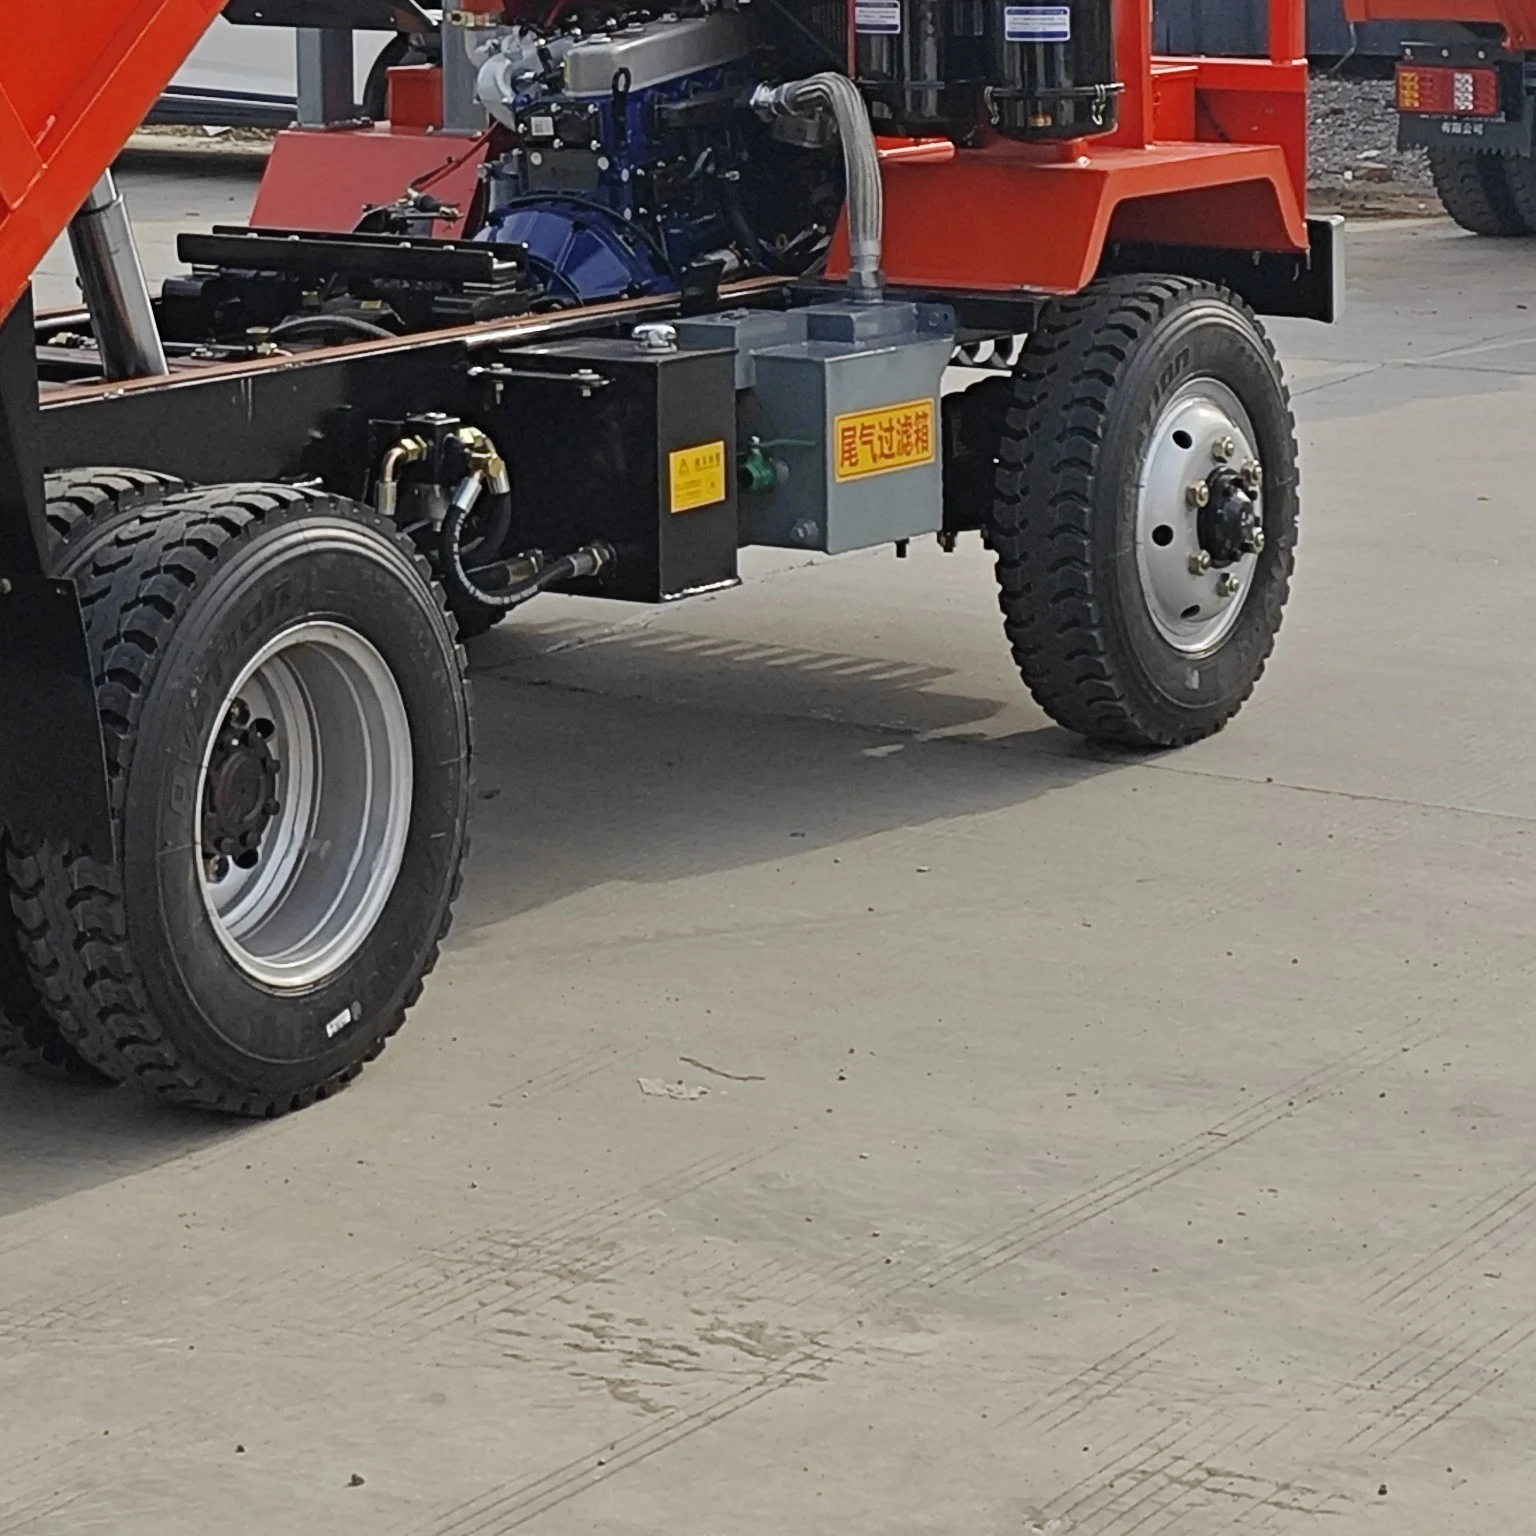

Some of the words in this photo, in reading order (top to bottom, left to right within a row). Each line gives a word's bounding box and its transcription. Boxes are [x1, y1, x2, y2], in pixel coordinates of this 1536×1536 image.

[840, 411, 929, 468] 尾气过滤箱
